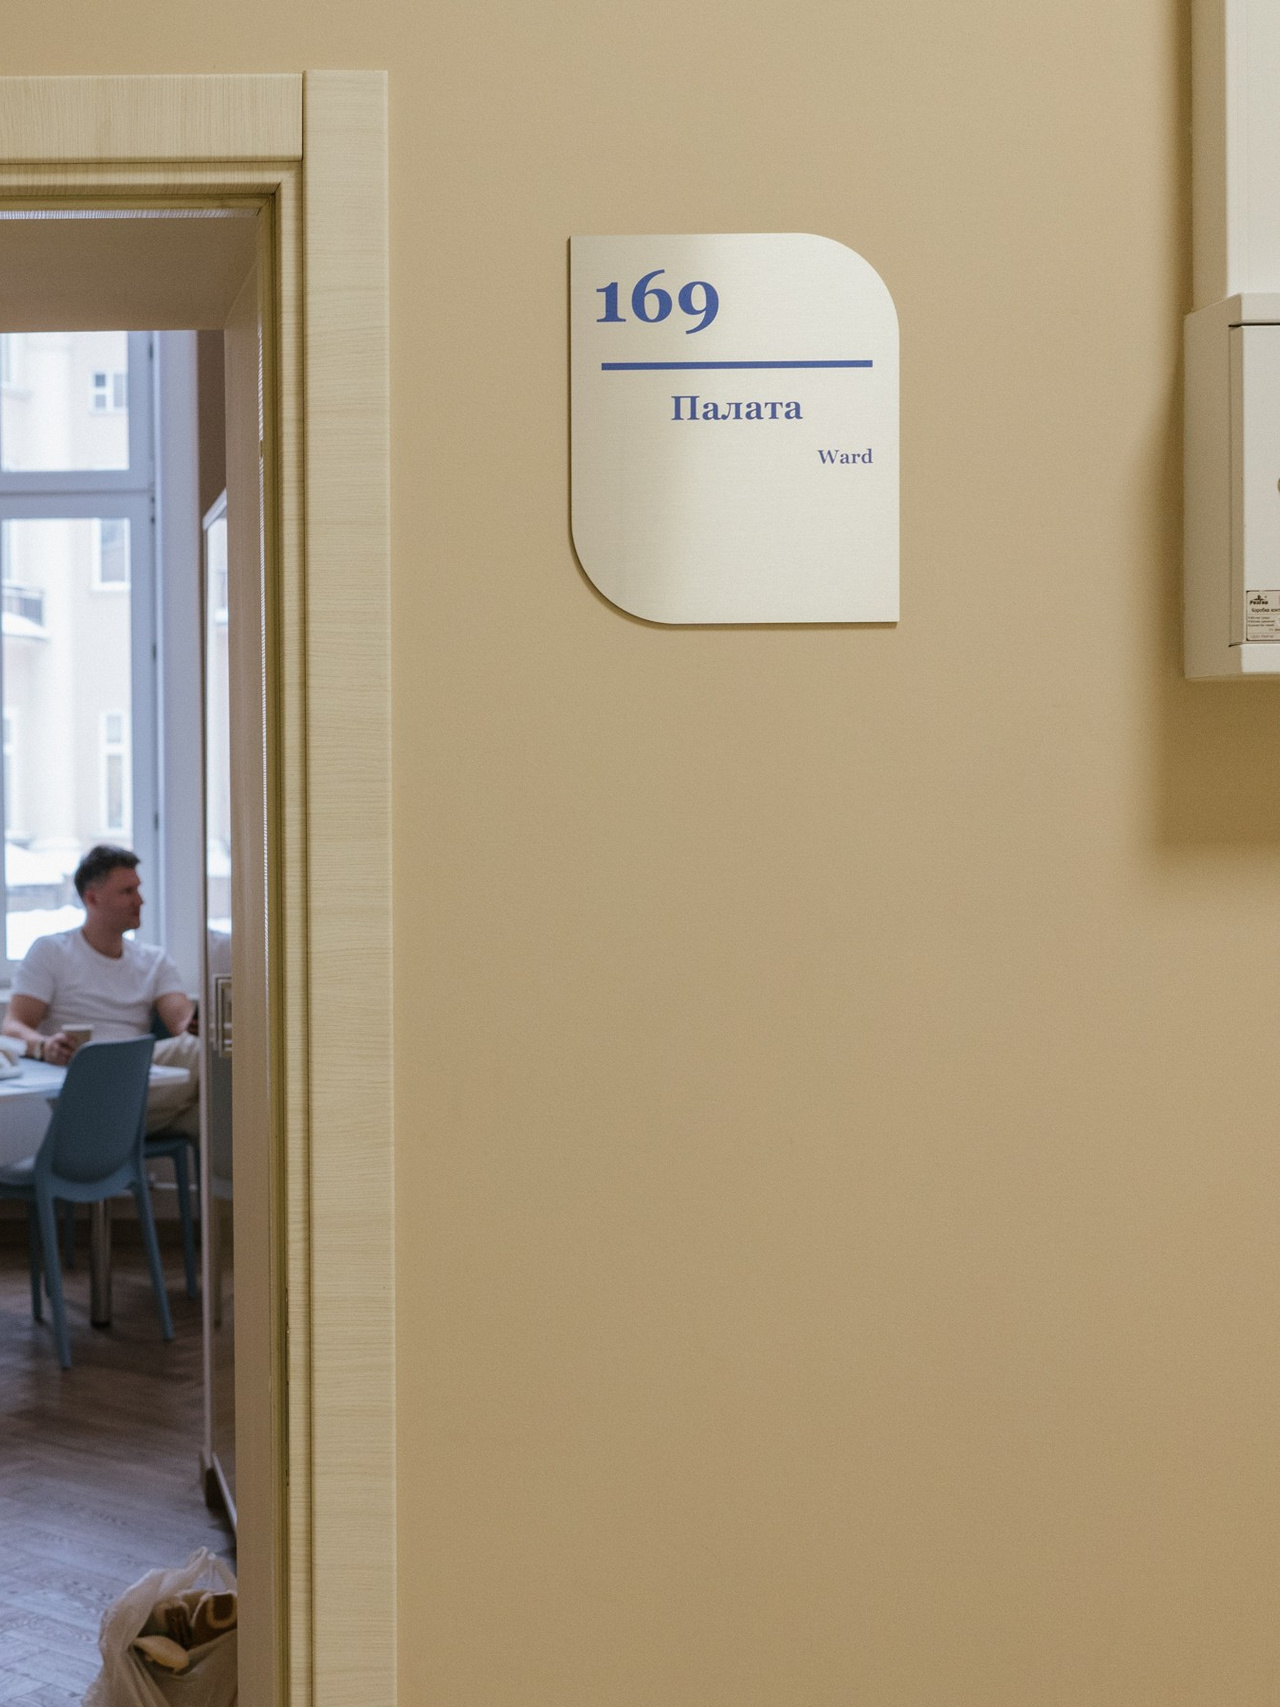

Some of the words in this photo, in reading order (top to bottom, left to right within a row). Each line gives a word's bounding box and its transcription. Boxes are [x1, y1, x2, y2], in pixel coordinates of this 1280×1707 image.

[595, 268, 719, 335] 169
[670, 394, 803, 422] Палата
[817, 448, 873, 465] Ward
